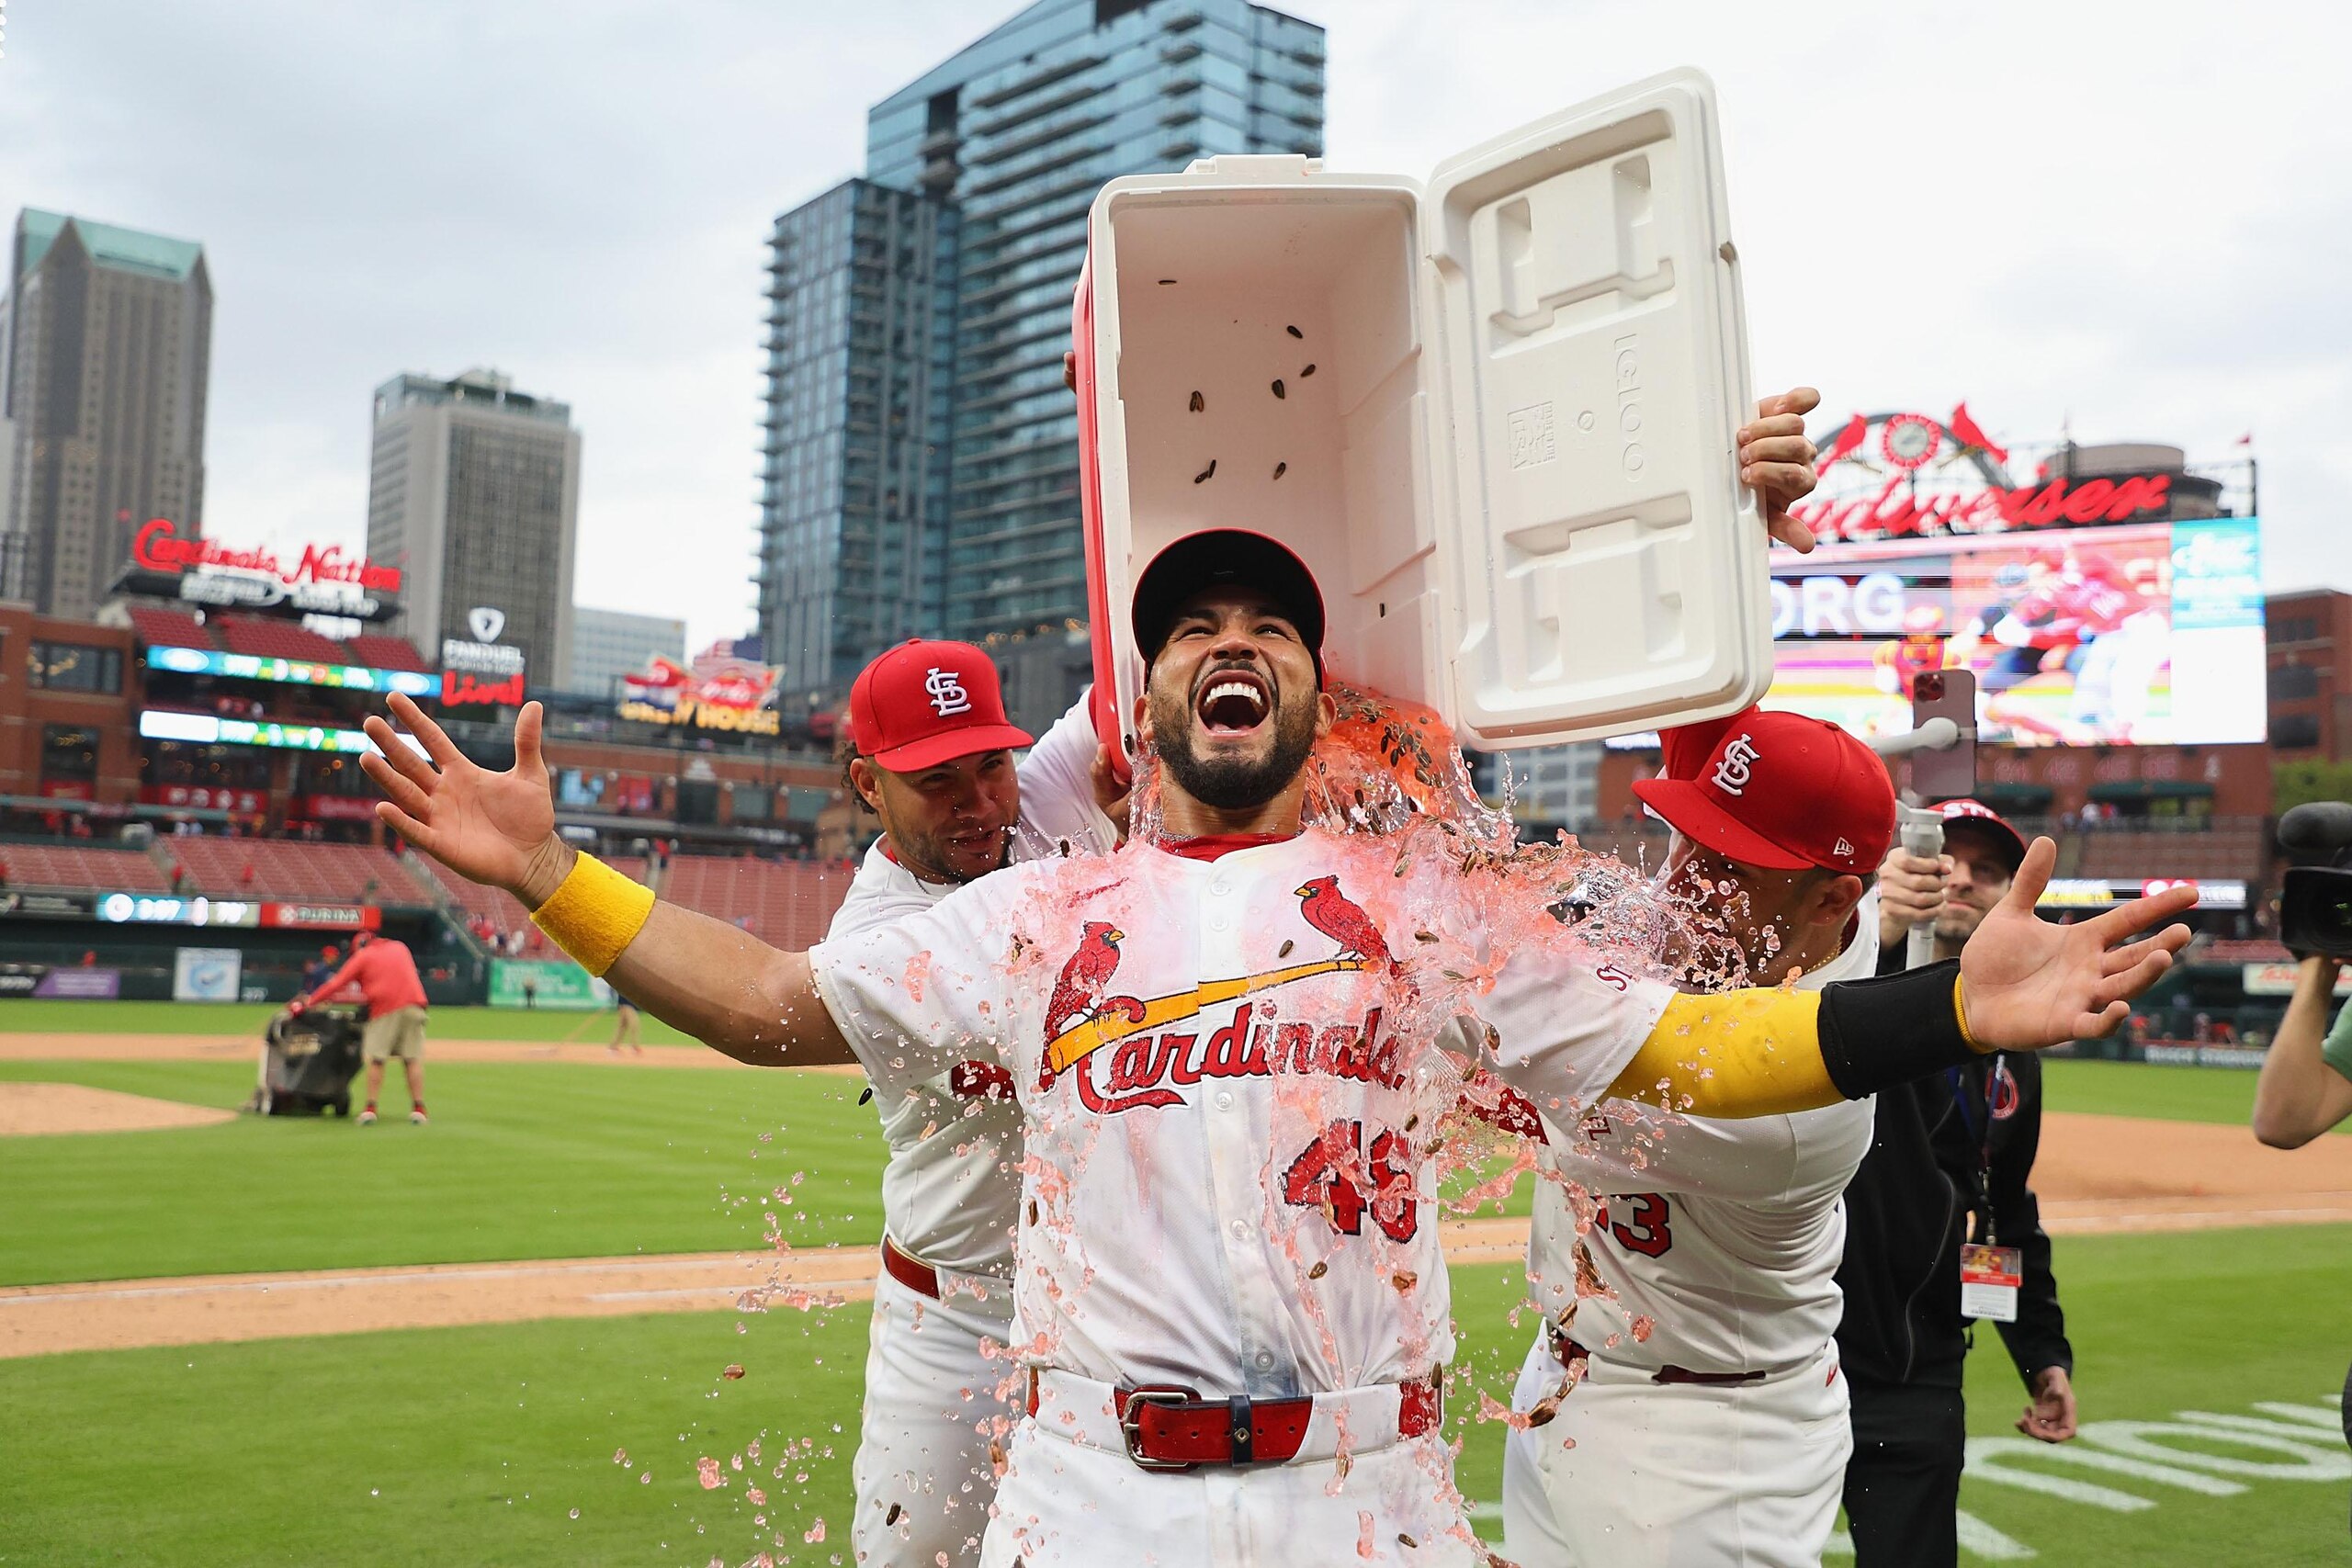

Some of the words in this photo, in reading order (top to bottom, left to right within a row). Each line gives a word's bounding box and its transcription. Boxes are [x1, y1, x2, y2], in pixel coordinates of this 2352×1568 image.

[1614, 333, 1645, 482] IGLOO
[1788, 461, 2174, 537] udweiser
[298, 906, 360, 922] PURINA
[1589, 1191, 1672, 1259] 3
